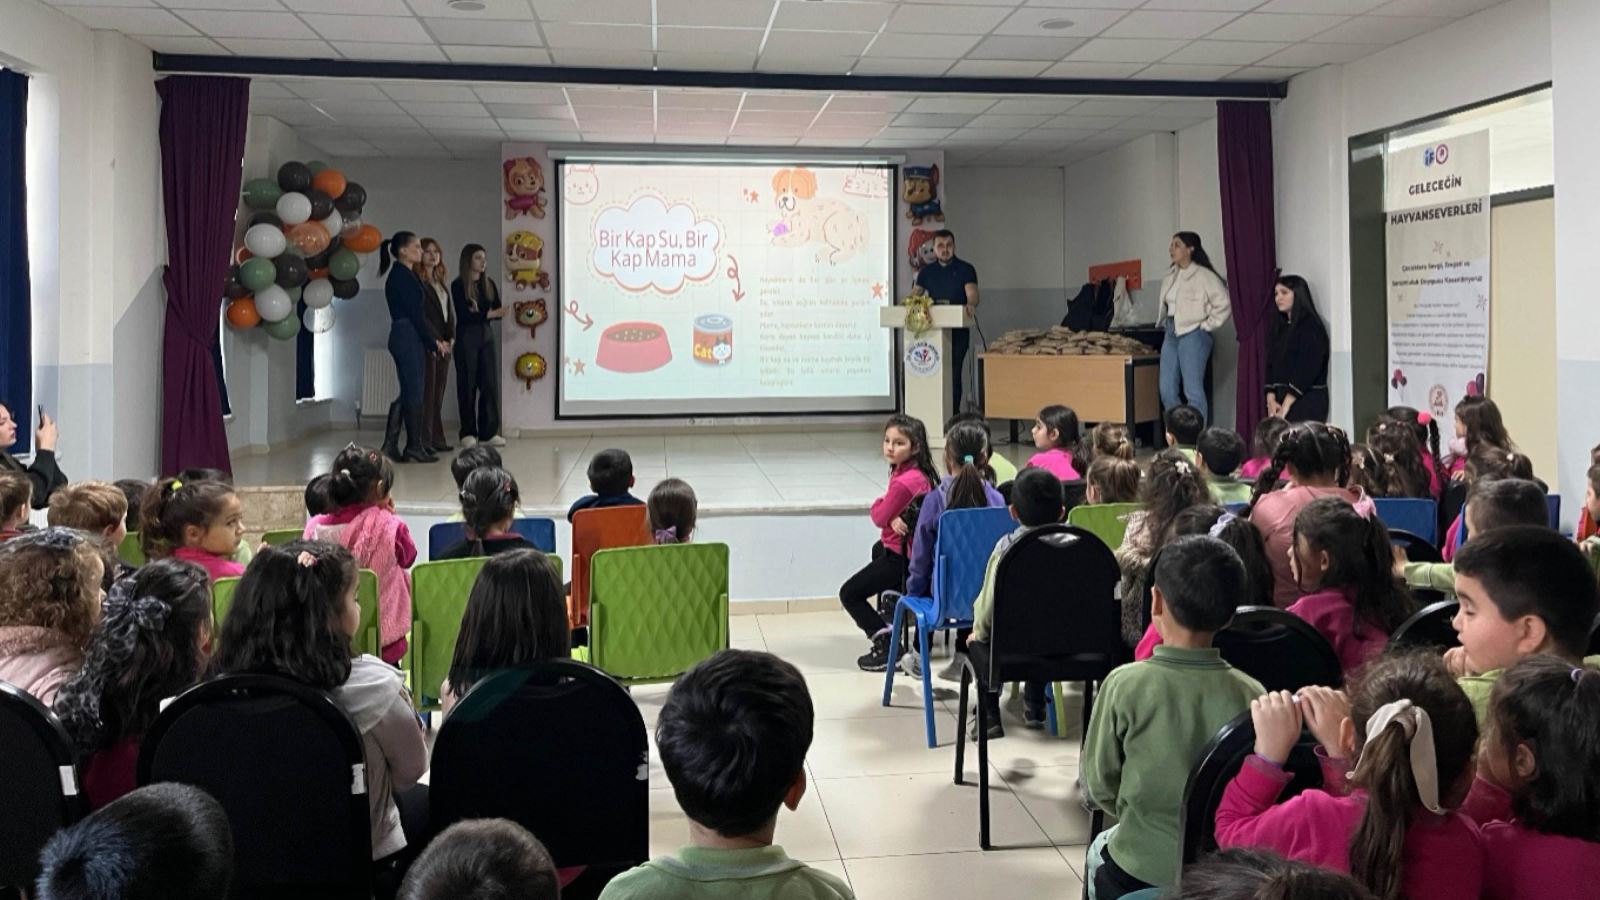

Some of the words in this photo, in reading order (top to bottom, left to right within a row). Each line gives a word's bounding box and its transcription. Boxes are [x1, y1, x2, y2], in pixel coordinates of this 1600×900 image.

[1408, 174, 1462, 196] GELECEĞİN
[1390, 198, 1483, 225] HAYVANSEVERLERİ
[599, 229, 622, 249] Bir
[625, 229, 656, 253] Kap
[658, 229, 683, 249] Su,
[685, 229, 709, 249] Bir
[611, 249, 642, 273] Kap
[645, 249, 697, 268] Mama
[694, 343, 713, 360] Cat
